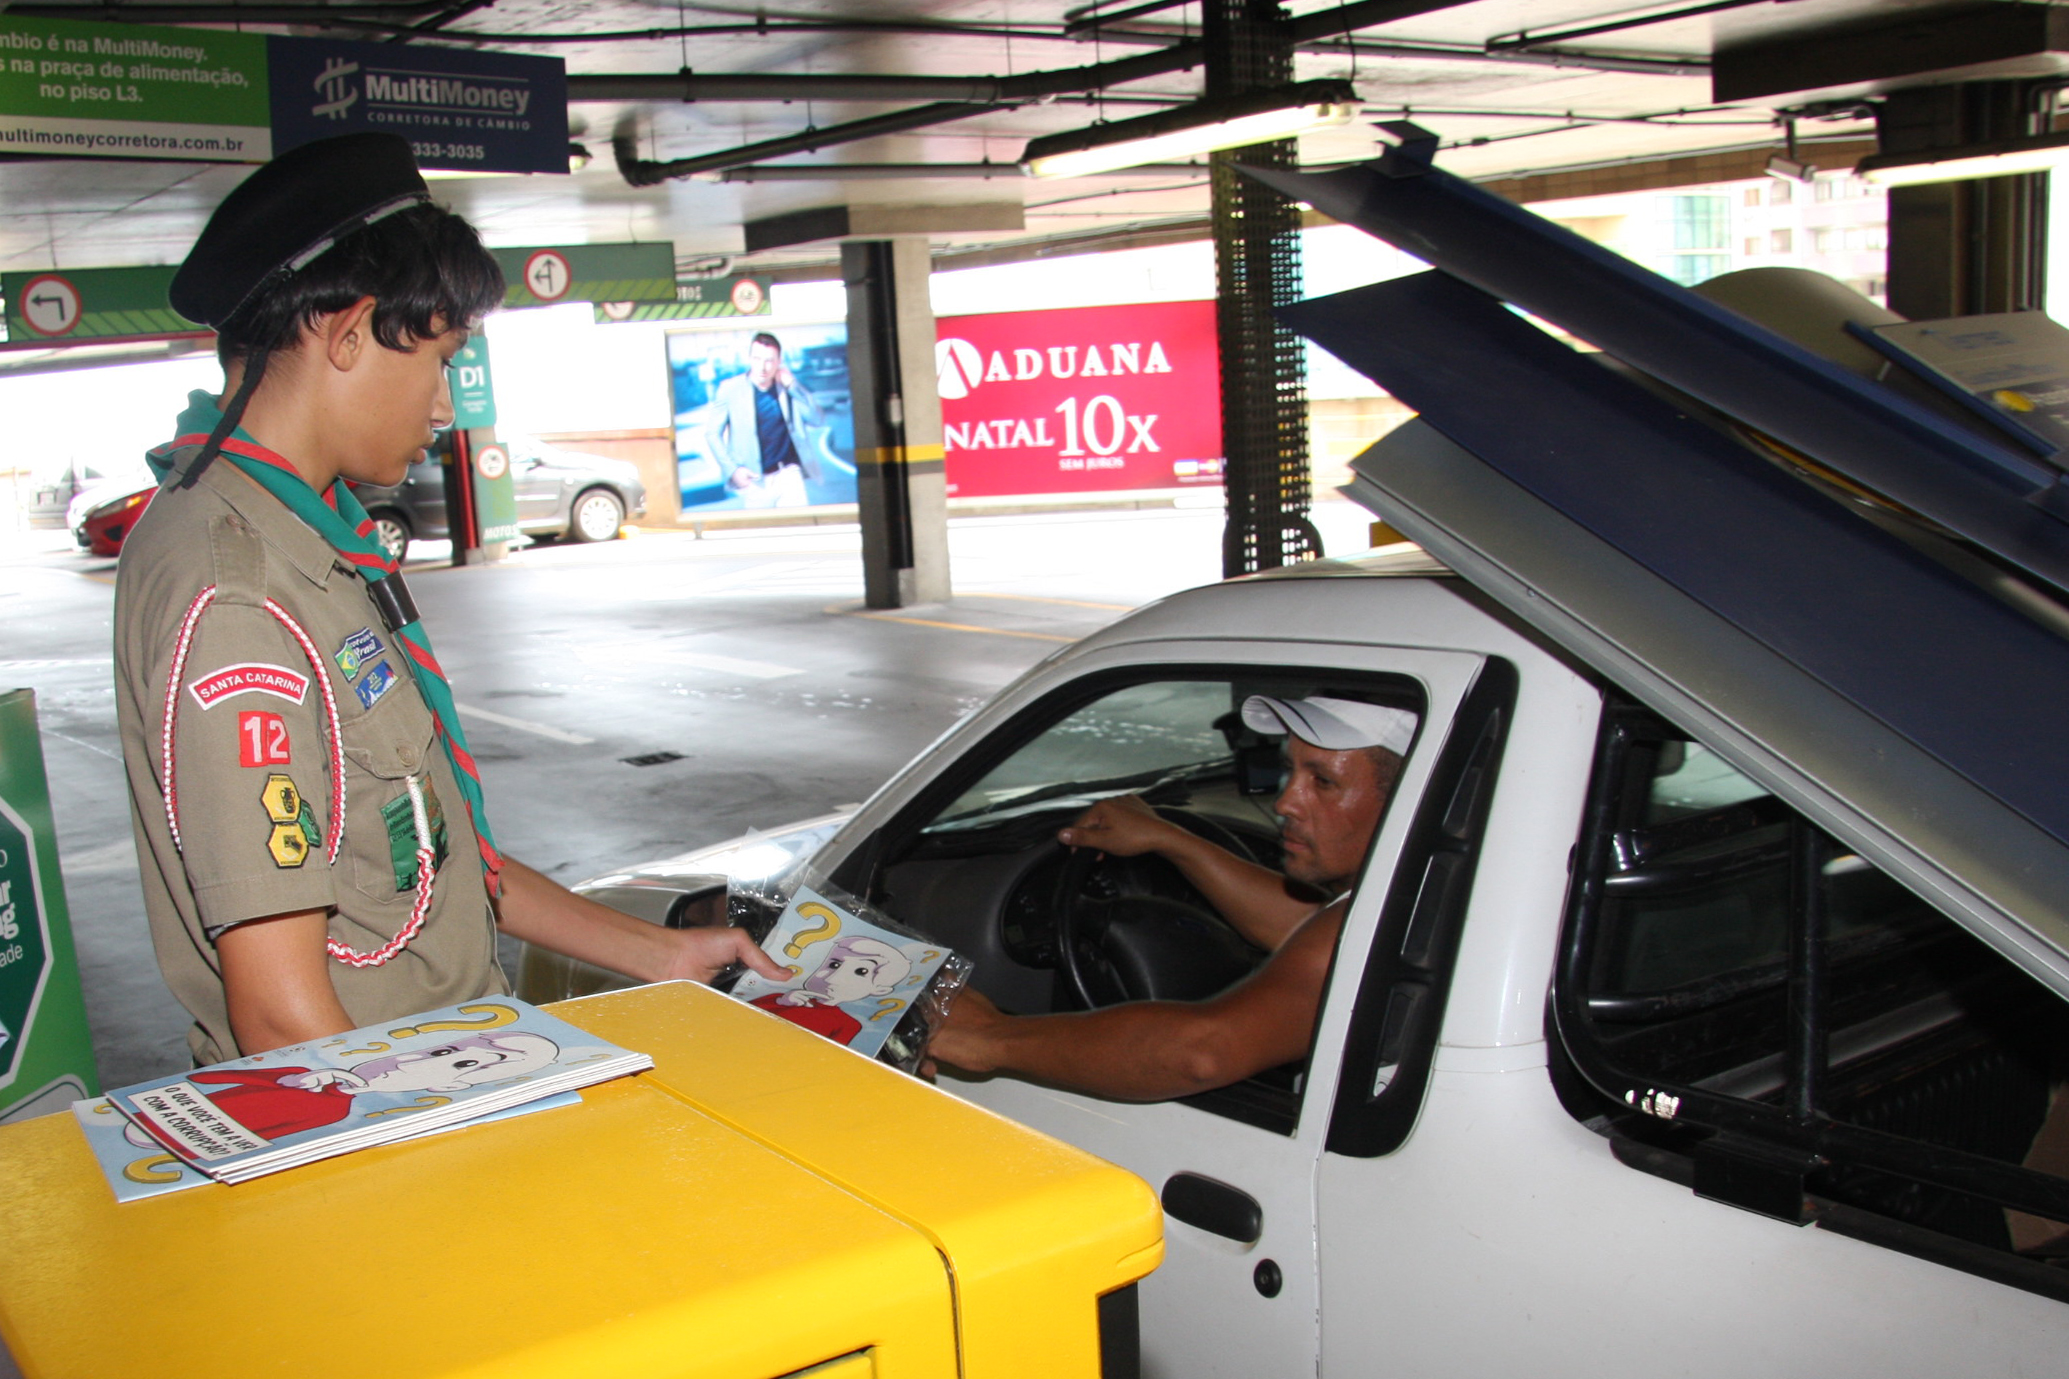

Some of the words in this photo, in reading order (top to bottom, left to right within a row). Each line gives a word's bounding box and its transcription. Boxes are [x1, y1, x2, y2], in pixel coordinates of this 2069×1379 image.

[47, 33, 59, 51] é
[64, 38, 89, 53] na
[94, 37, 208, 63] MultiMoney.
[10, 59, 35, 74] na
[40, 60, 95, 81] praça
[100, 61, 125, 78] de
[129, 63, 249, 89] alimentação,
[40, 83, 65, 98] no
[70, 83, 111, 102] piso
[116, 84, 143, 102] L3.
[365, 74, 530, 116] MultiMoney
[367, 111, 451, 126] CORRETORA
[455, 117, 472, 128] DE
[477, 116, 532, 131] CÂMBIO
[0, 128, 244, 152] ultimoneycorretora.com.br
[985, 341, 1172, 382] ADUANA
[459, 365, 486, 389] D1
[944, 417, 1055, 450] NATAL
[200, 674, 244, 698] SANTA
[245, 672, 302, 695] CATARINA
[244, 716, 289, 763] 12
[143, 1095, 171, 1113] COM
[171, 1092, 198, 1107] QUE
[187, 1105, 220, 1124] VOCÊ
[207, 1121, 231, 1137] TEM
[223, 1134, 242, 1142] A
